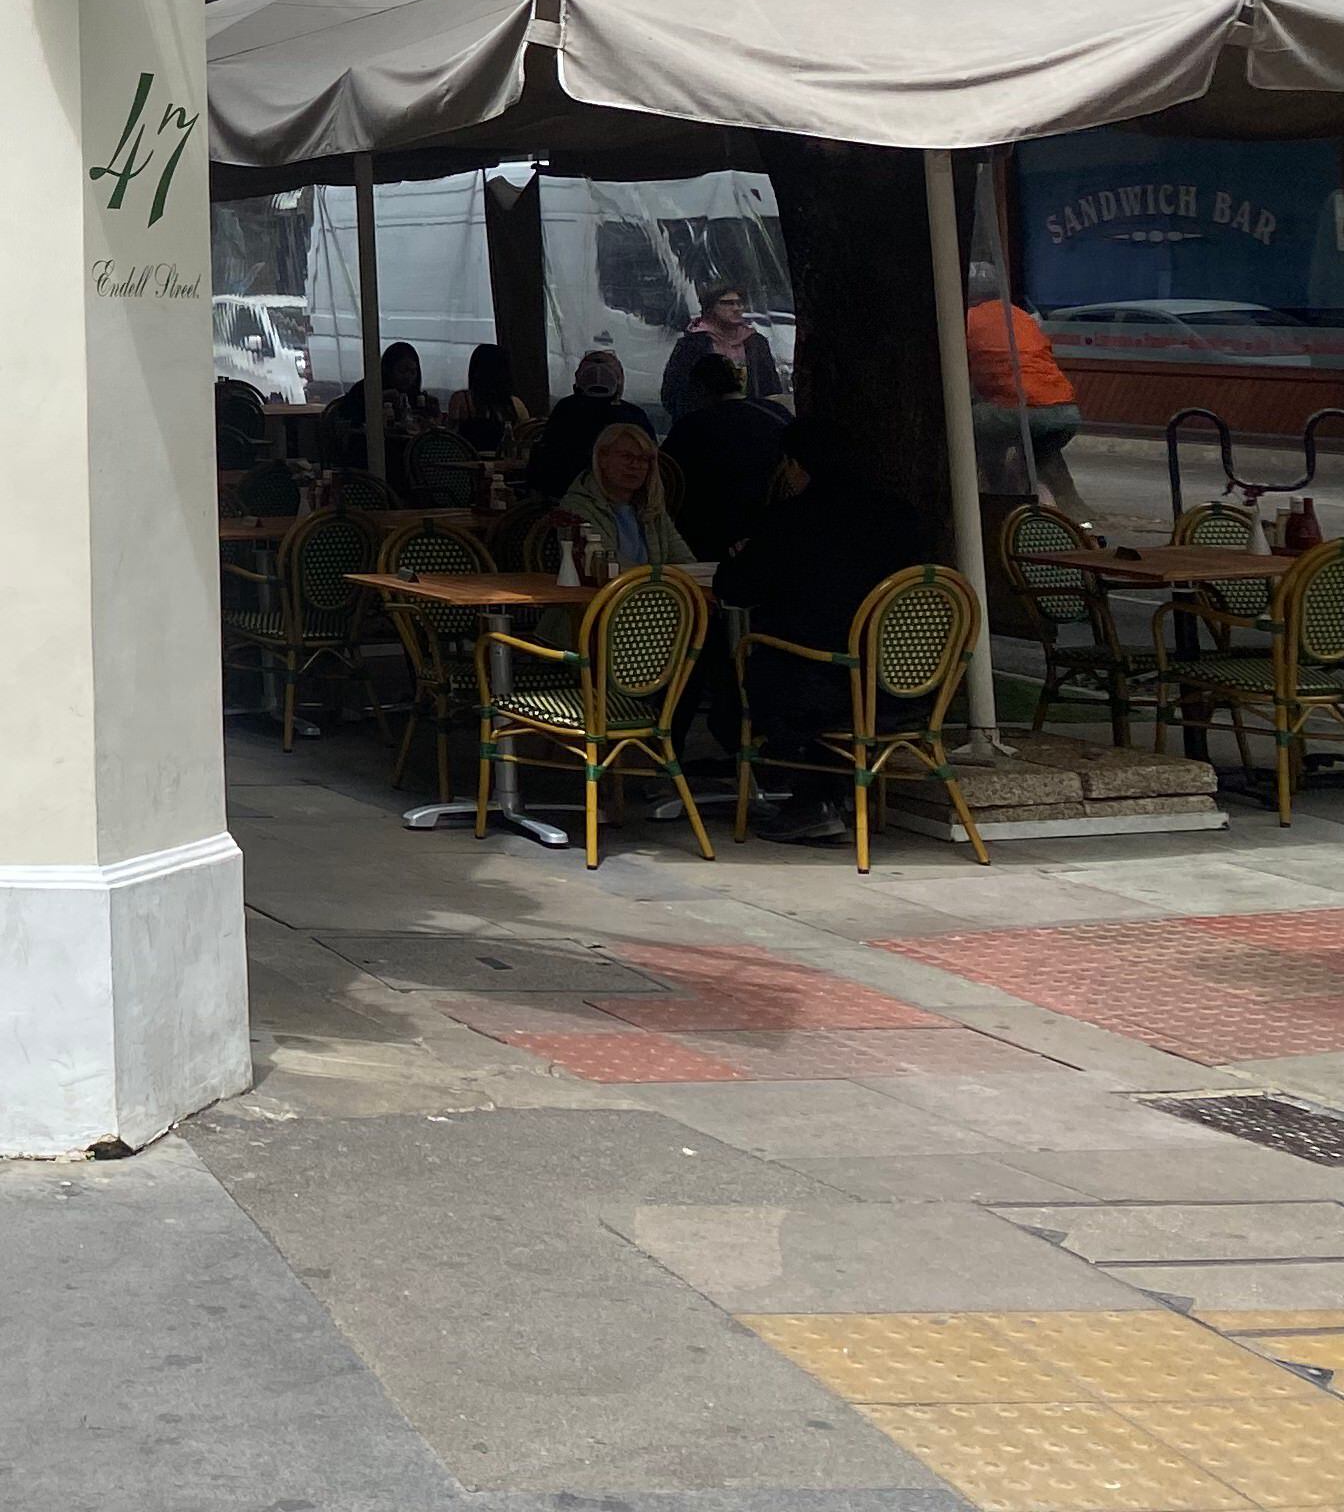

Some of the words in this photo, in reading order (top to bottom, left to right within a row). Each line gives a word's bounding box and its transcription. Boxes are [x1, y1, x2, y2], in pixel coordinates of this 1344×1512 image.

[89, 72, 200, 229] 47
[1046, 184, 1199, 245] SANDWICH
[1213, 190, 1277, 246] BAR
[91, 259, 152, 299] Endell
